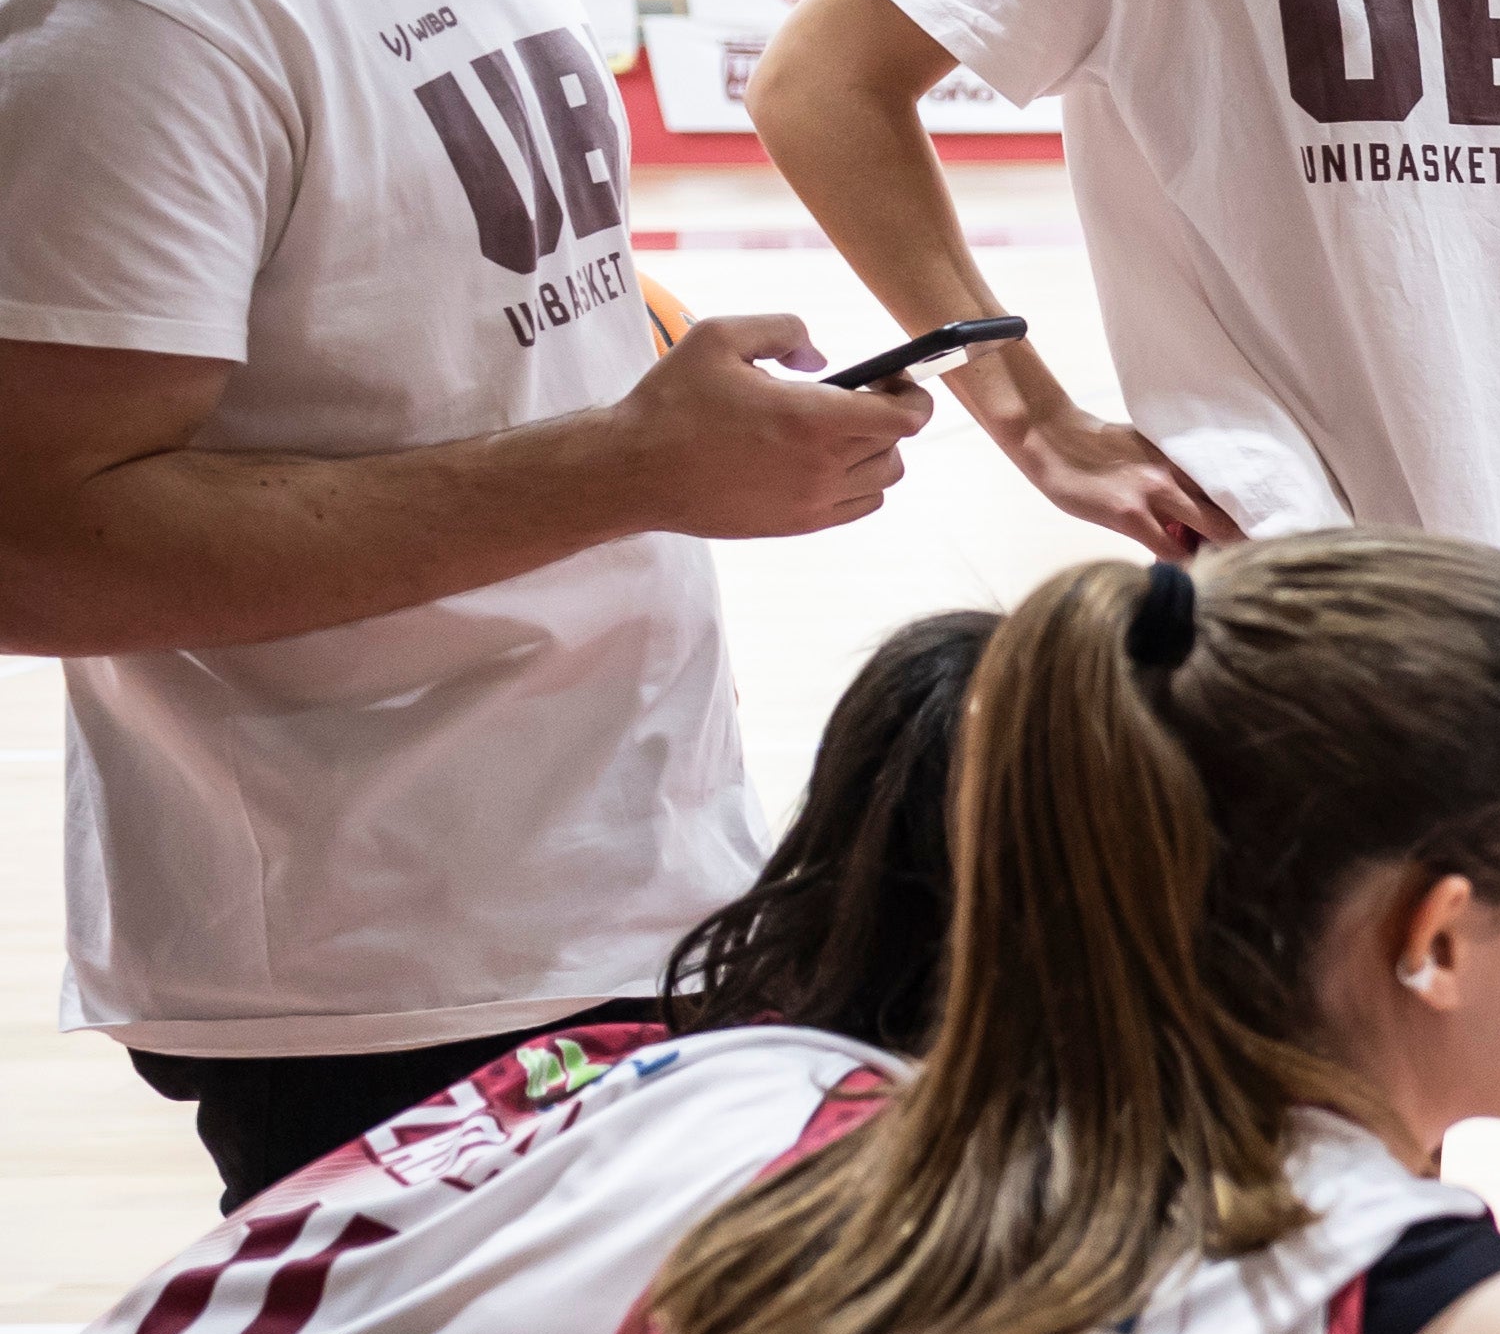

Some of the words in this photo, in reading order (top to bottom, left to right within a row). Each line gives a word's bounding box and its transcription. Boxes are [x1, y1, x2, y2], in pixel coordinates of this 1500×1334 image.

[408, 6, 457, 43] WIBO
[413, 25, 627, 276] UB
[503, 251, 627, 349] UIBASKET
